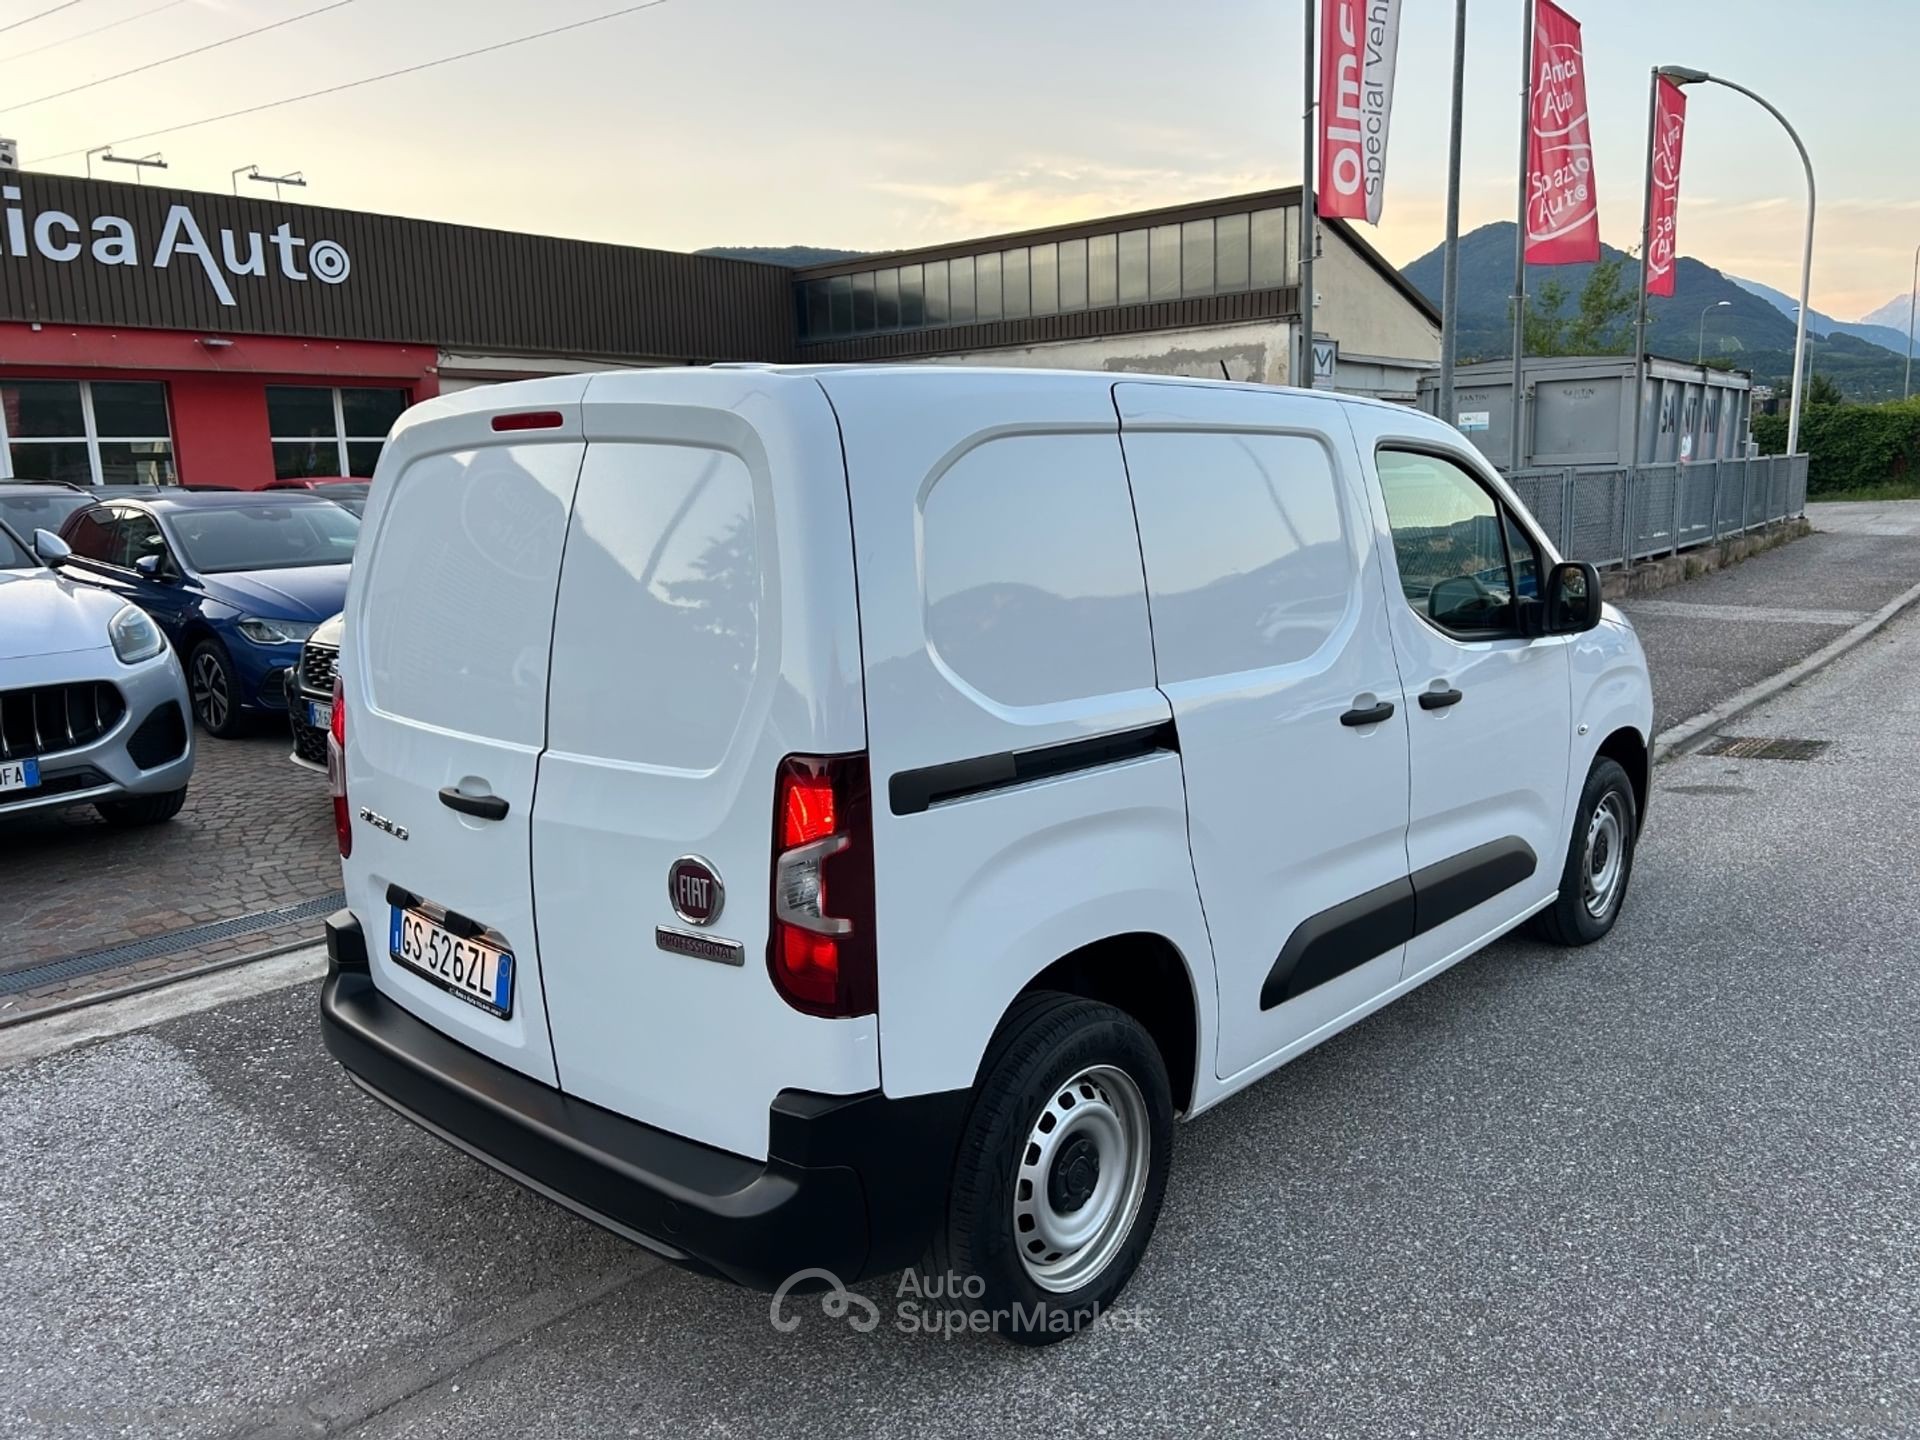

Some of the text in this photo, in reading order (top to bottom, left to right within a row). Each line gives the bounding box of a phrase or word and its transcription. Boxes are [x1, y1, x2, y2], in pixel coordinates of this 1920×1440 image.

[1363, 0, 1389, 196] Special Veh
[1532, 157, 1590, 200] Spazio
[1538, 184, 1588, 228] Auto
[0, 185, 351, 306] ica Auto
[680, 874, 710, 909] FIAT
[660, 933, 734, 960] PROFESSIONAL
